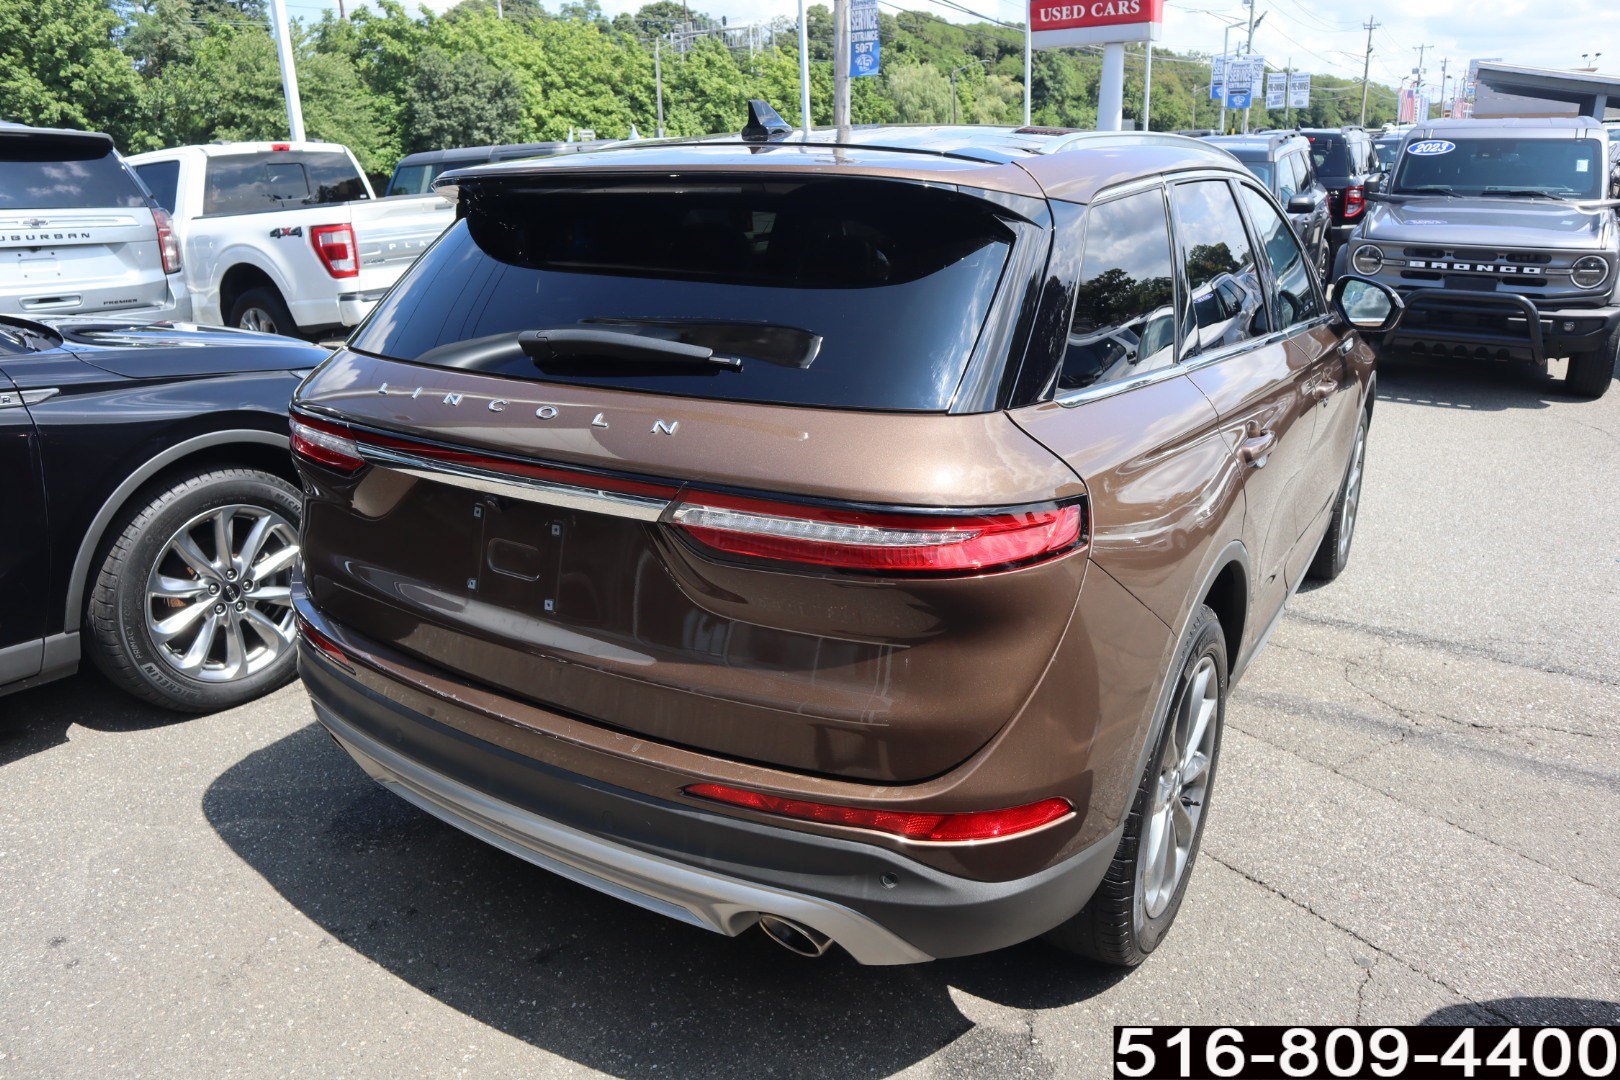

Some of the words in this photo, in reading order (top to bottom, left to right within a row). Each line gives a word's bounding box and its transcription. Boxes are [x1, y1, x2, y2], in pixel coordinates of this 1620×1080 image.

[1040, 5, 1086, 22] USED
[1091, 0, 1140, 17] CARS
[851, 9, 878, 31] SERVICE
[1413, 142, 1449, 153] 2023
[0, 232, 91, 242] UBURBAN
[389, 240, 427, 251] PLA
[1409, 260, 1541, 275] BRONCO
[103, 298, 138, 306] PREMIER
[377, 382, 679, 436] LINCOLN
[144, 664, 200, 699] MICHELIN
